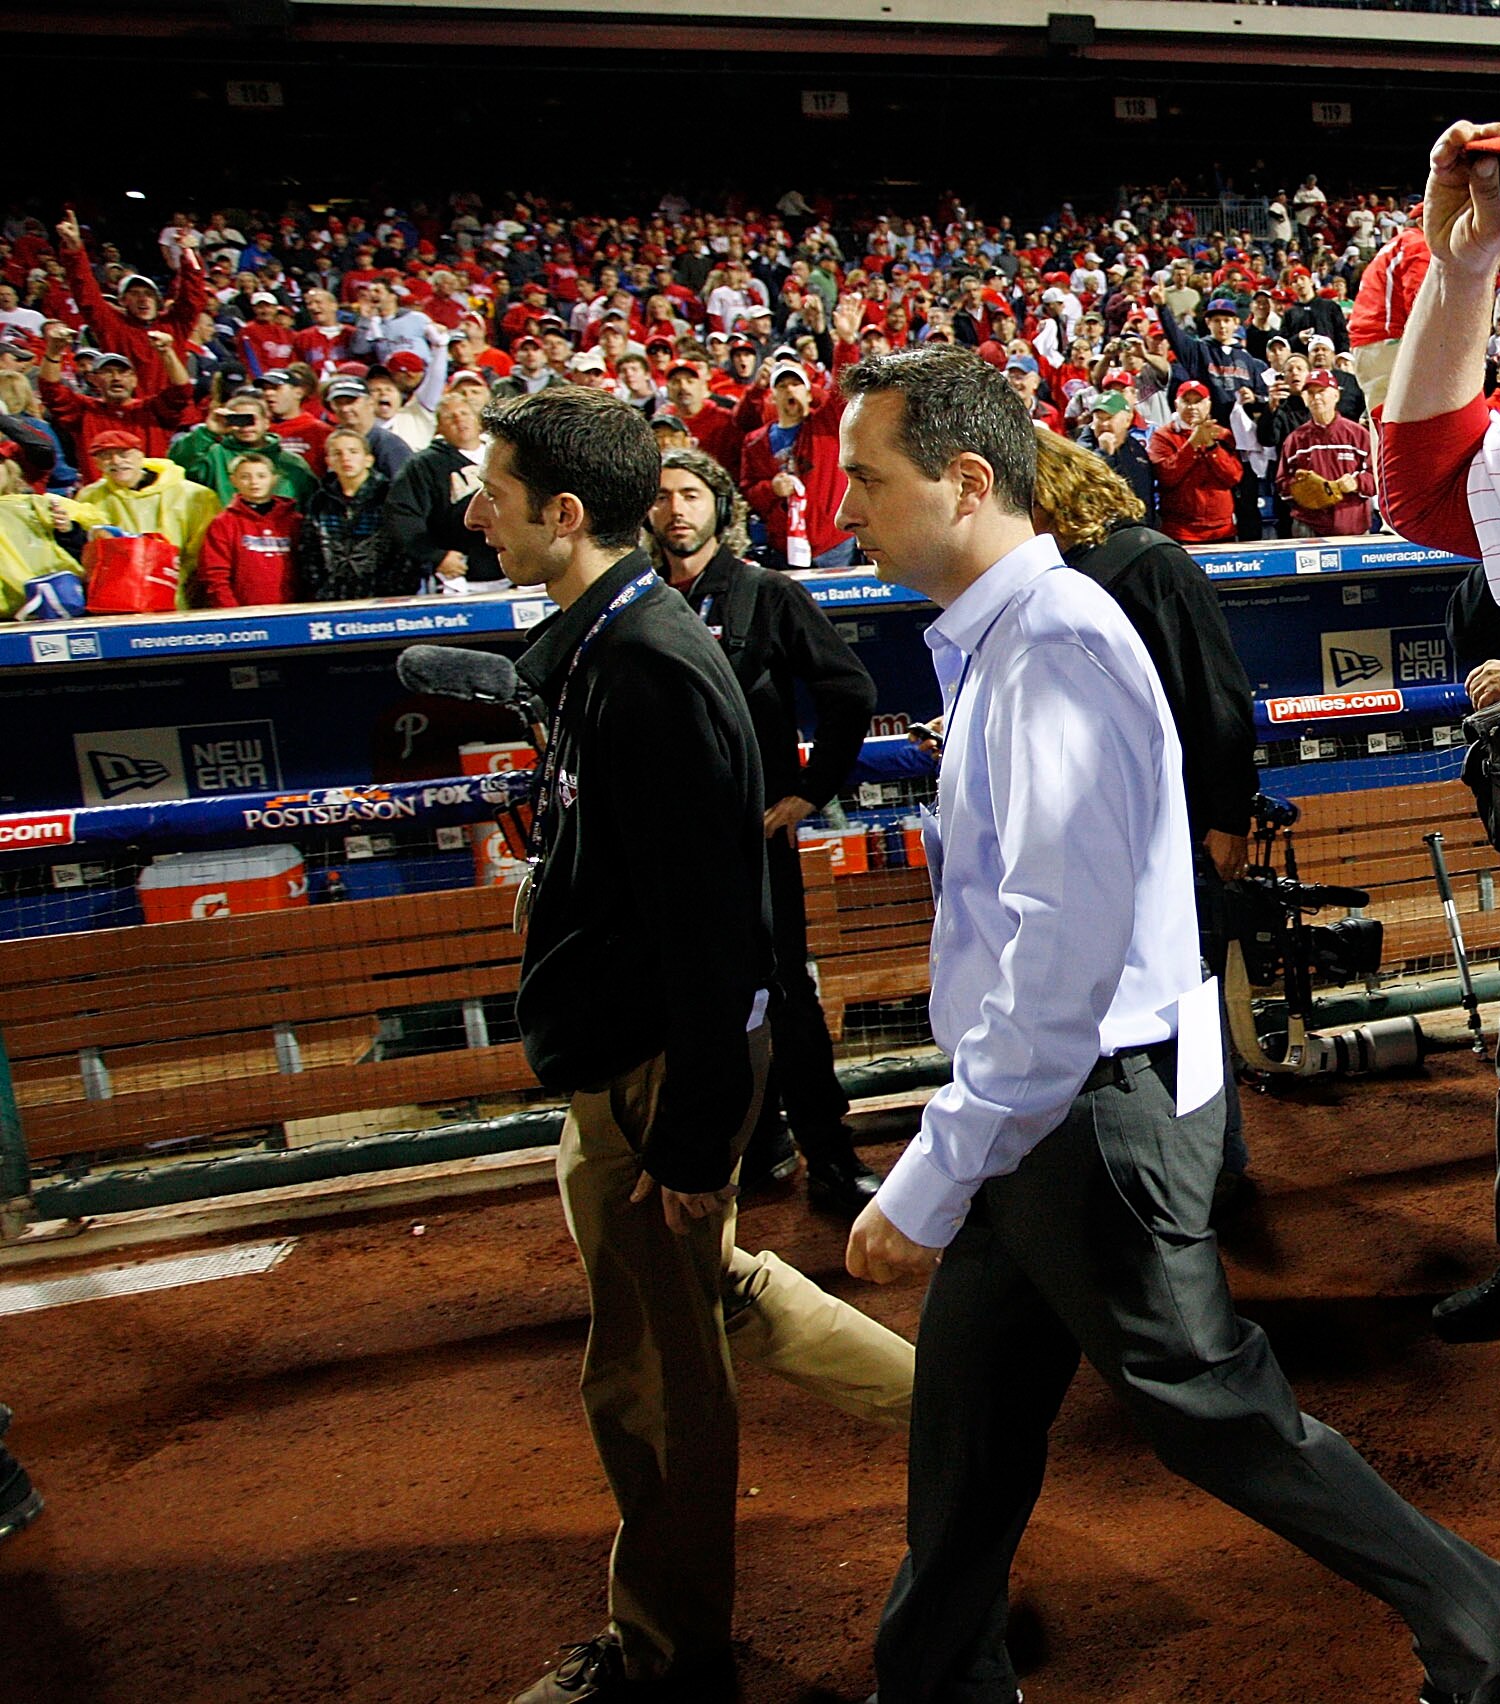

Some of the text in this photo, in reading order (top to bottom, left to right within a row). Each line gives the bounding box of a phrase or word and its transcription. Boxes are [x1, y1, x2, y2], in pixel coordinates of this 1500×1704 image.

[1205, 560, 1261, 575] Bank Park
[1361, 549, 1455, 564] neweracap.com
[828, 587, 862, 600] Bank
[862, 585, 892, 599] Park
[334, 612, 469, 637] Citizens Bank Park
[130, 629, 269, 650] neweracap.com
[1399, 639, 1446, 661] NEW
[1401, 659, 1447, 682] ERA
[1274, 691, 1397, 719] phillies.com
[394, 712, 430, 759] P
[191, 738, 263, 767] NEW
[198, 763, 268, 791] ERA
[422, 783, 473, 808] FOX
[242, 796, 416, 830] POSTSEASON
